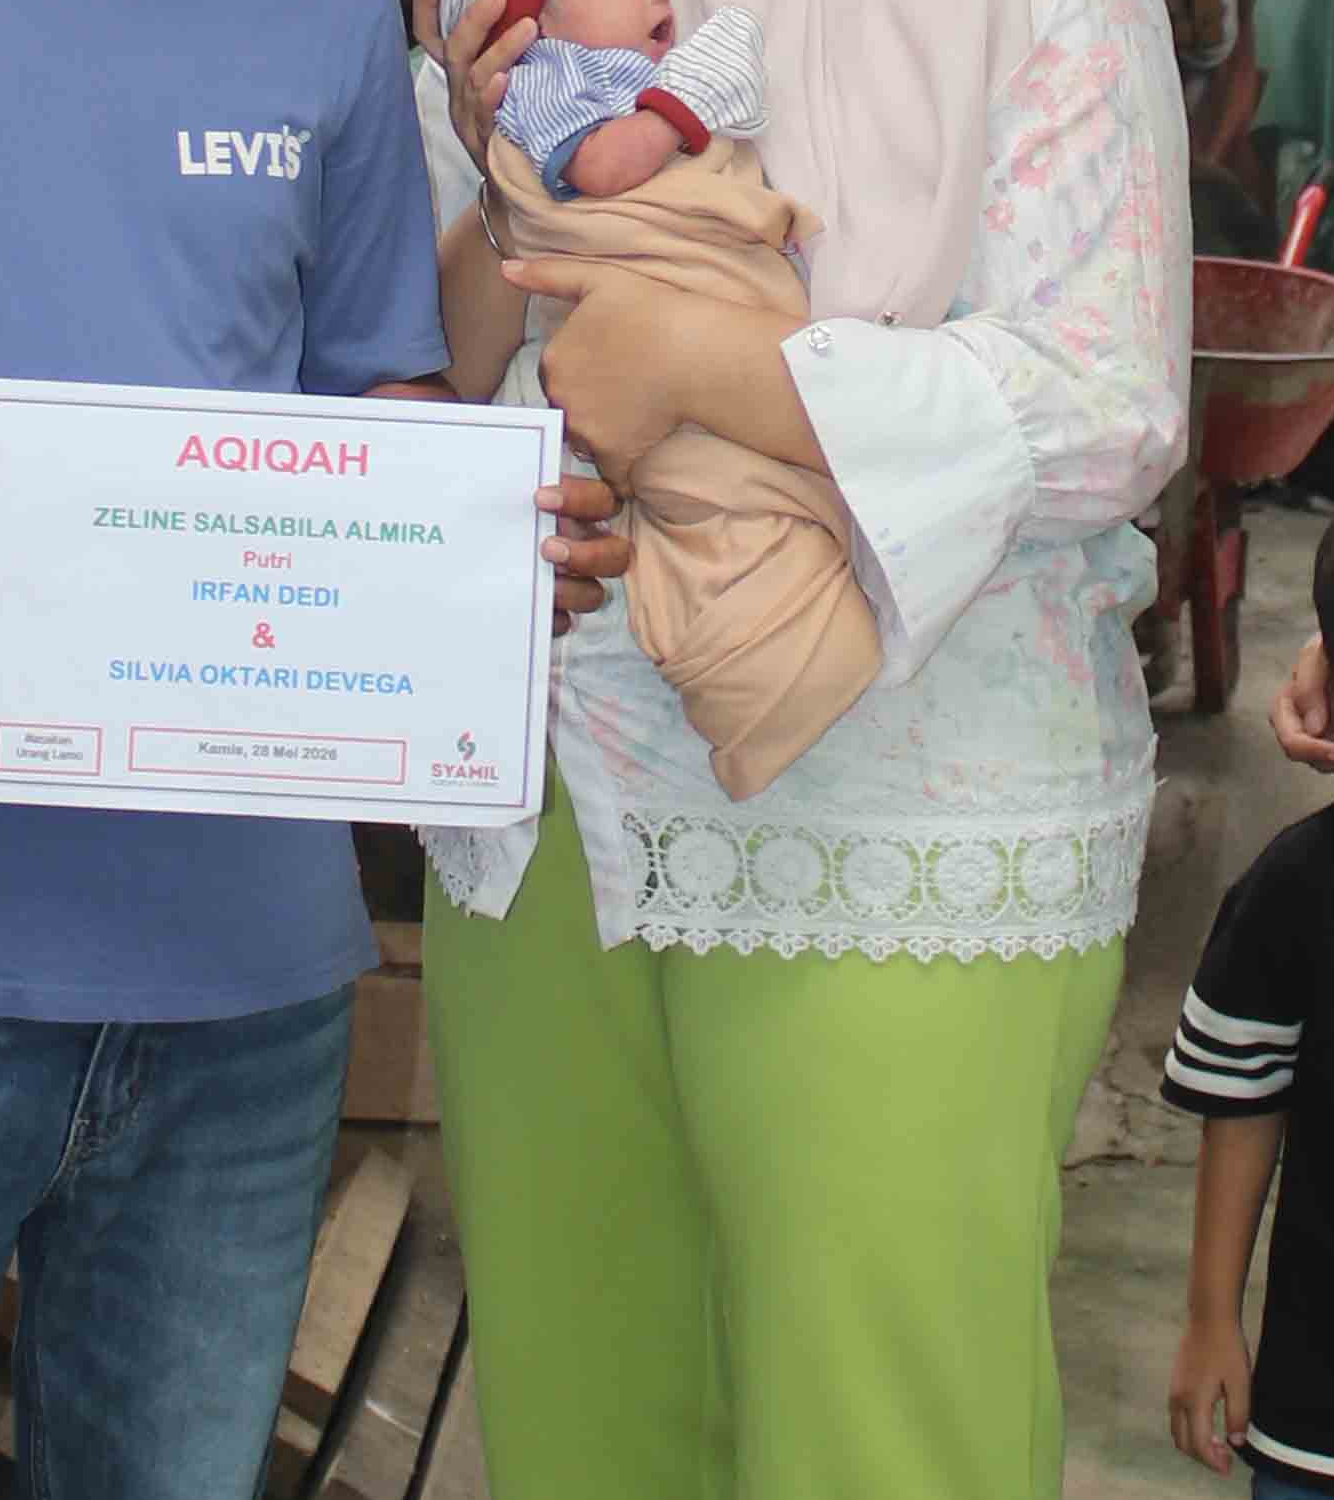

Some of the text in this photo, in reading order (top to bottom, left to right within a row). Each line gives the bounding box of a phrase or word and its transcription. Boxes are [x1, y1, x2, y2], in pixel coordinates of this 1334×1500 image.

[176, 432, 369, 477] AQIQAH
[93, 505, 444, 545] ZELINE SALSABILA ALMIRA
[242, 550, 292, 570] Putri
[192, 580, 340, 608] IRFAN DEDI
[251, 622, 276, 650] &
[109, 659, 414, 696] SILVIA OKTARI DEVEGA
[198, 741, 248, 760] Kamis,
[272, 745, 299, 760] Mei
[431, 763, 499, 781] SYAMIL
